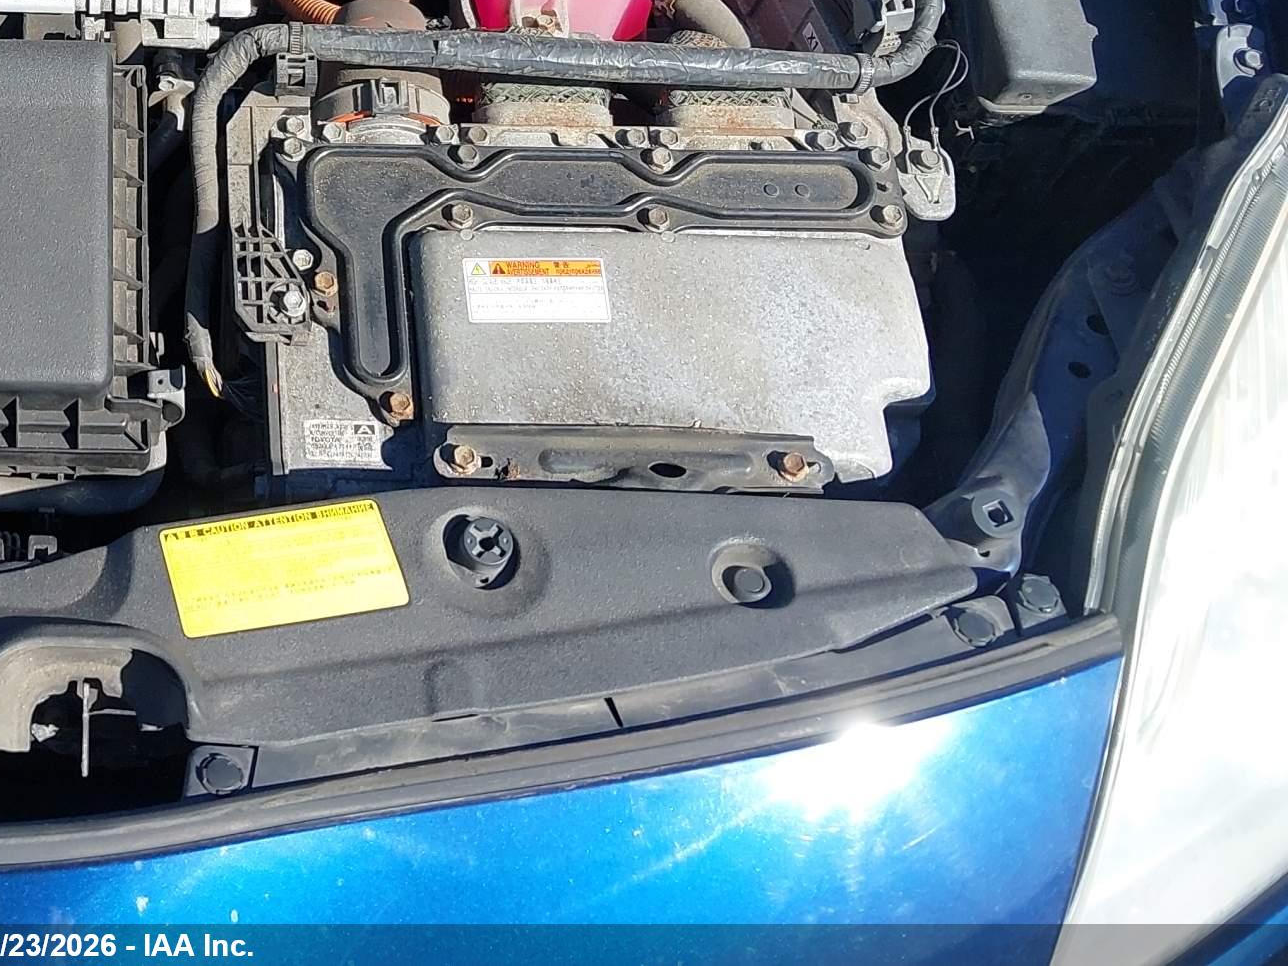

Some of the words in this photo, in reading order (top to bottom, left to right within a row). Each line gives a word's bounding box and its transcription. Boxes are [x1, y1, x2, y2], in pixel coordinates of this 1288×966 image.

[204, 521, 249, 536] CAUTION
[254, 512, 312, 528] ATTENTION
[316, 503, 373, 519] ВНИМАНИЕ
